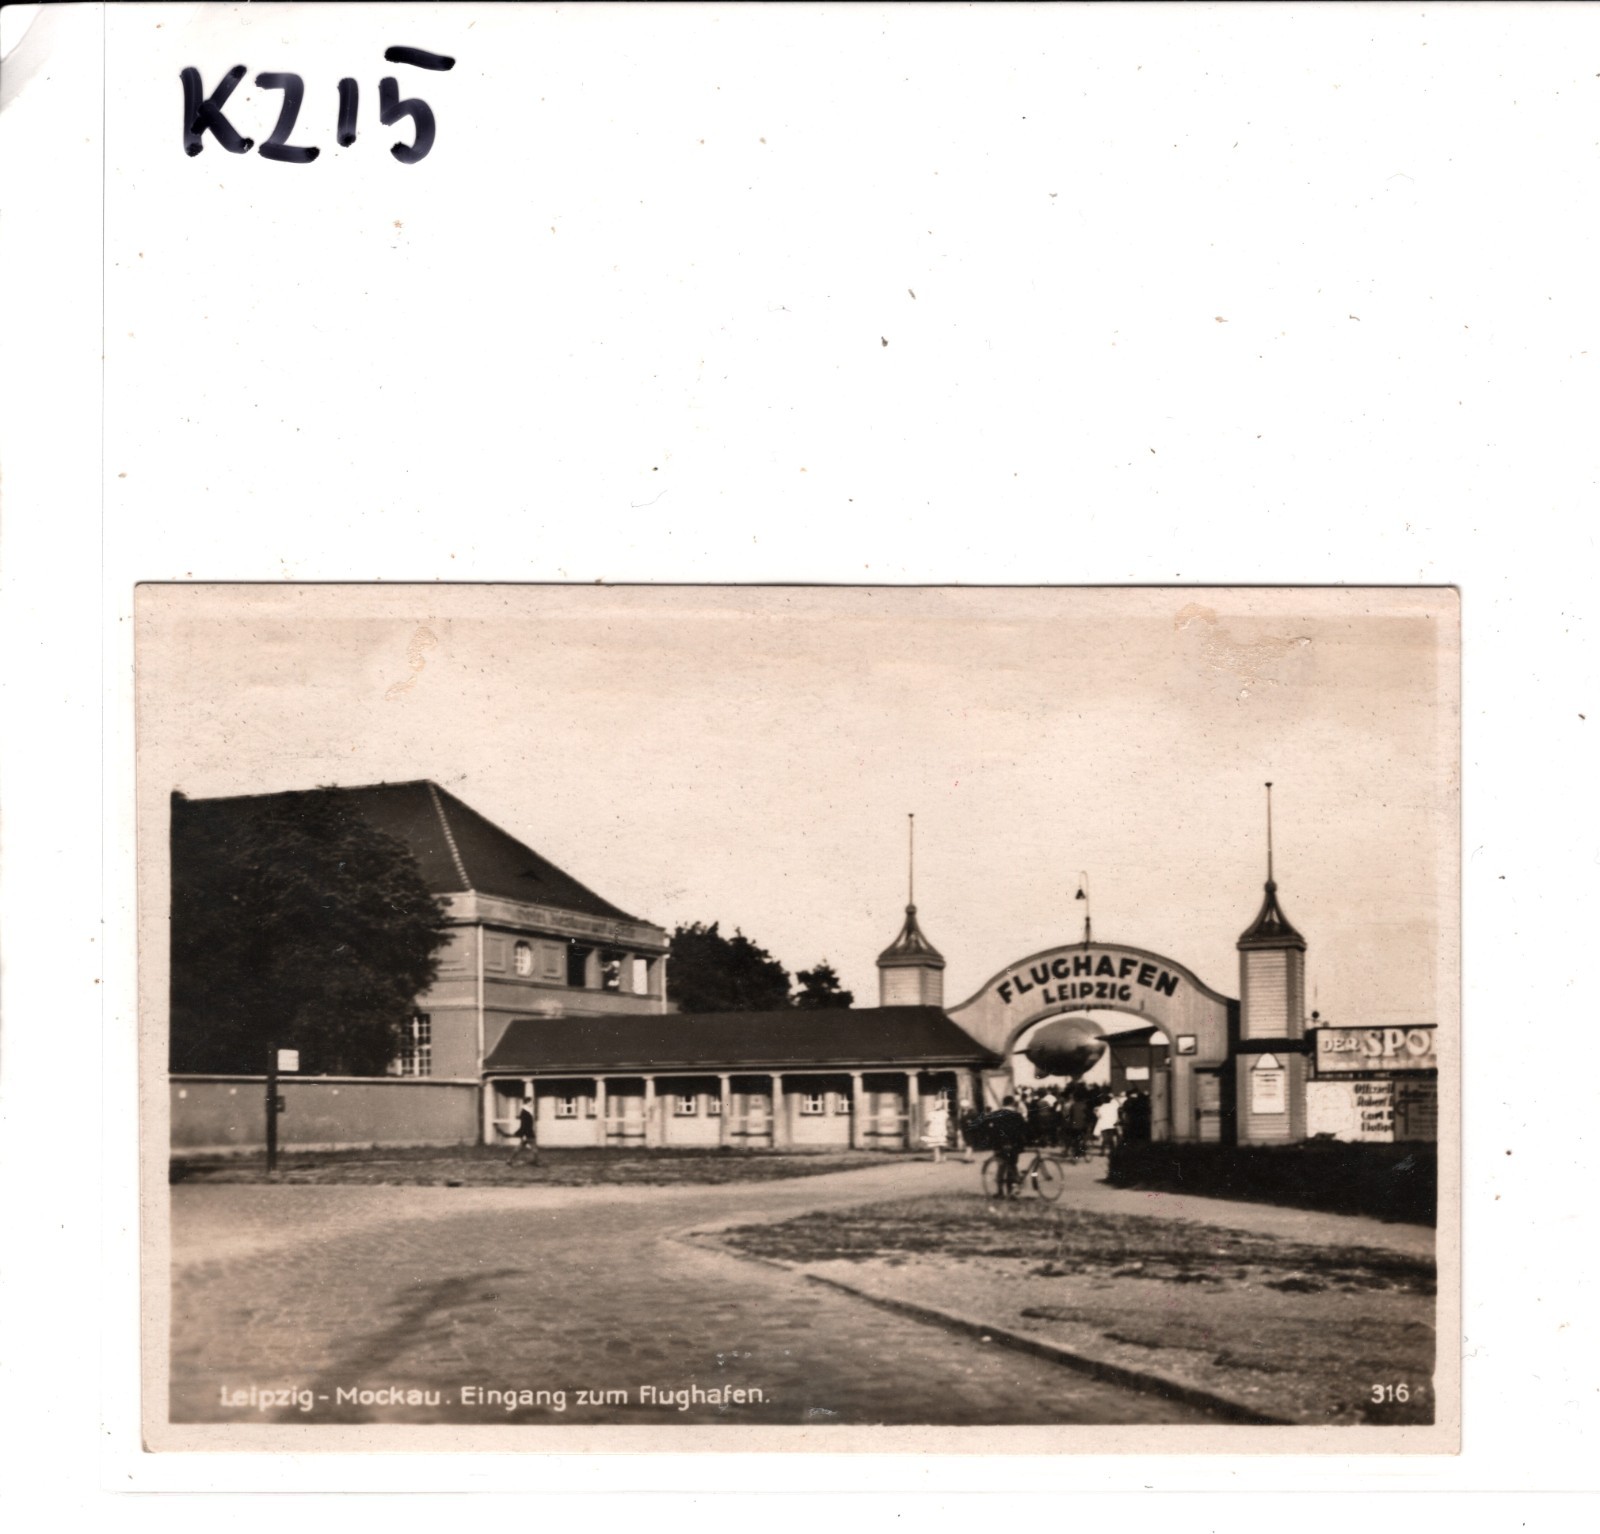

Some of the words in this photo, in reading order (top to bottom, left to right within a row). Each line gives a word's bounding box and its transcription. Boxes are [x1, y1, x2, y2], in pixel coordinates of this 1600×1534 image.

[179, 45, 456, 165] K215
[997, 955, 1179, 1004] FLUGHAFEN
[1042, 982, 1132, 1005] LEIPZIG
[1321, 1037, 1360, 1053] DER
[1361, 1028, 1437, 1058] SPO
